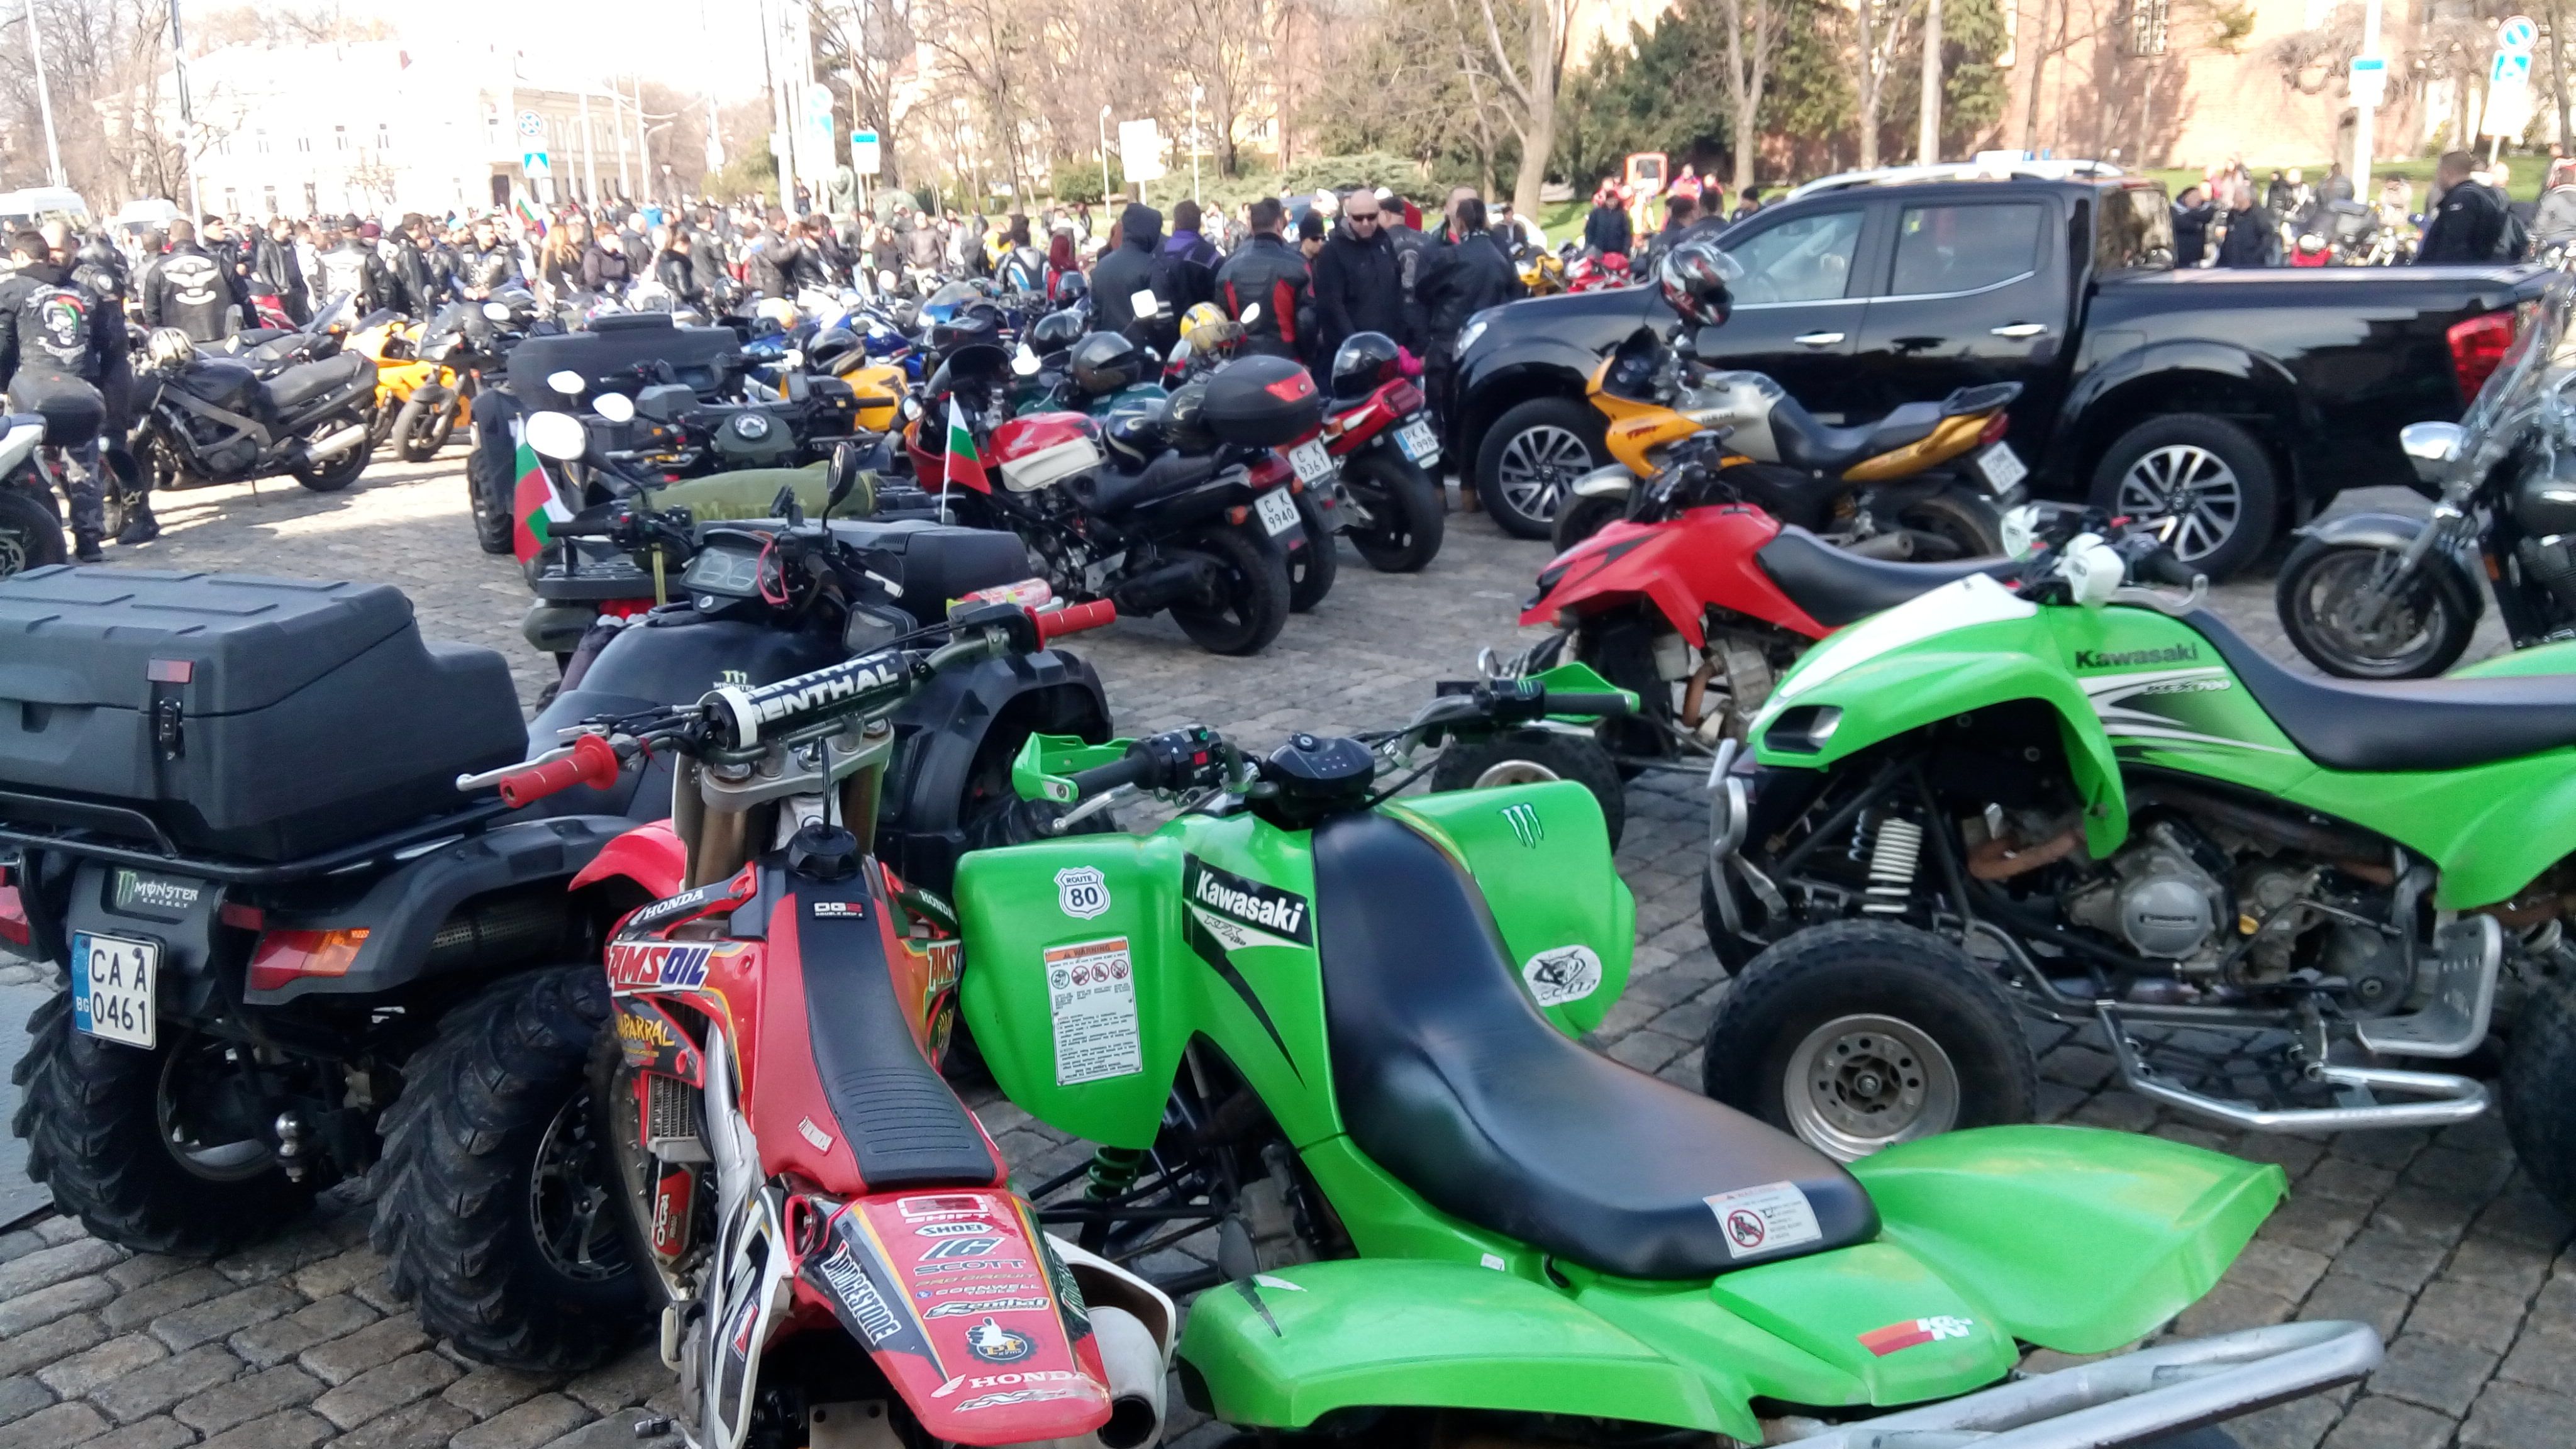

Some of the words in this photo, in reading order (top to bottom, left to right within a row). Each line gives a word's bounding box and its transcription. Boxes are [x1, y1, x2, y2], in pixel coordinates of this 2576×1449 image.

[1296, 450, 1306, 463] C
[1311, 443, 1321, 456] K
[1412, 436, 1435, 454] 1998
[1300, 455, 1327, 477] 9361
[1264, 499, 1274, 513] C
[1278, 492, 1291, 506] K
[1269, 508, 1294, 529] 9940
[2075, 642, 2198, 669] Kawasaki
[1066, 875, 1092, 884] ROUTE
[142, 897, 188, 909] ENERGY
[643, 889, 704, 921] HONDA
[1070, 887, 1098, 907] 80
[1196, 869, 1304, 934] Kawasaki
[1074, 945, 1111, 957] WARNING
[91, 948, 123, 988] CA
[133, 955, 147, 993] A
[610, 945, 711, 992] AMSOIL
[75, 996, 90, 1013] BG
[92, 991, 147, 1035] 0461
[904, 1213, 991, 1224] SHIFT
[923, 1224, 983, 1235] SHOEI
[914, 1259, 1027, 1276] SCOTT
[914, 1277, 957, 1287] PRO
[962, 1273, 1035, 1282] CIRCUIT
[819, 1239, 896, 1346] BRIDGESTONE
[923, 1297, 1049, 1319] Renthal
[969, 1370, 1089, 1389] HONDA
